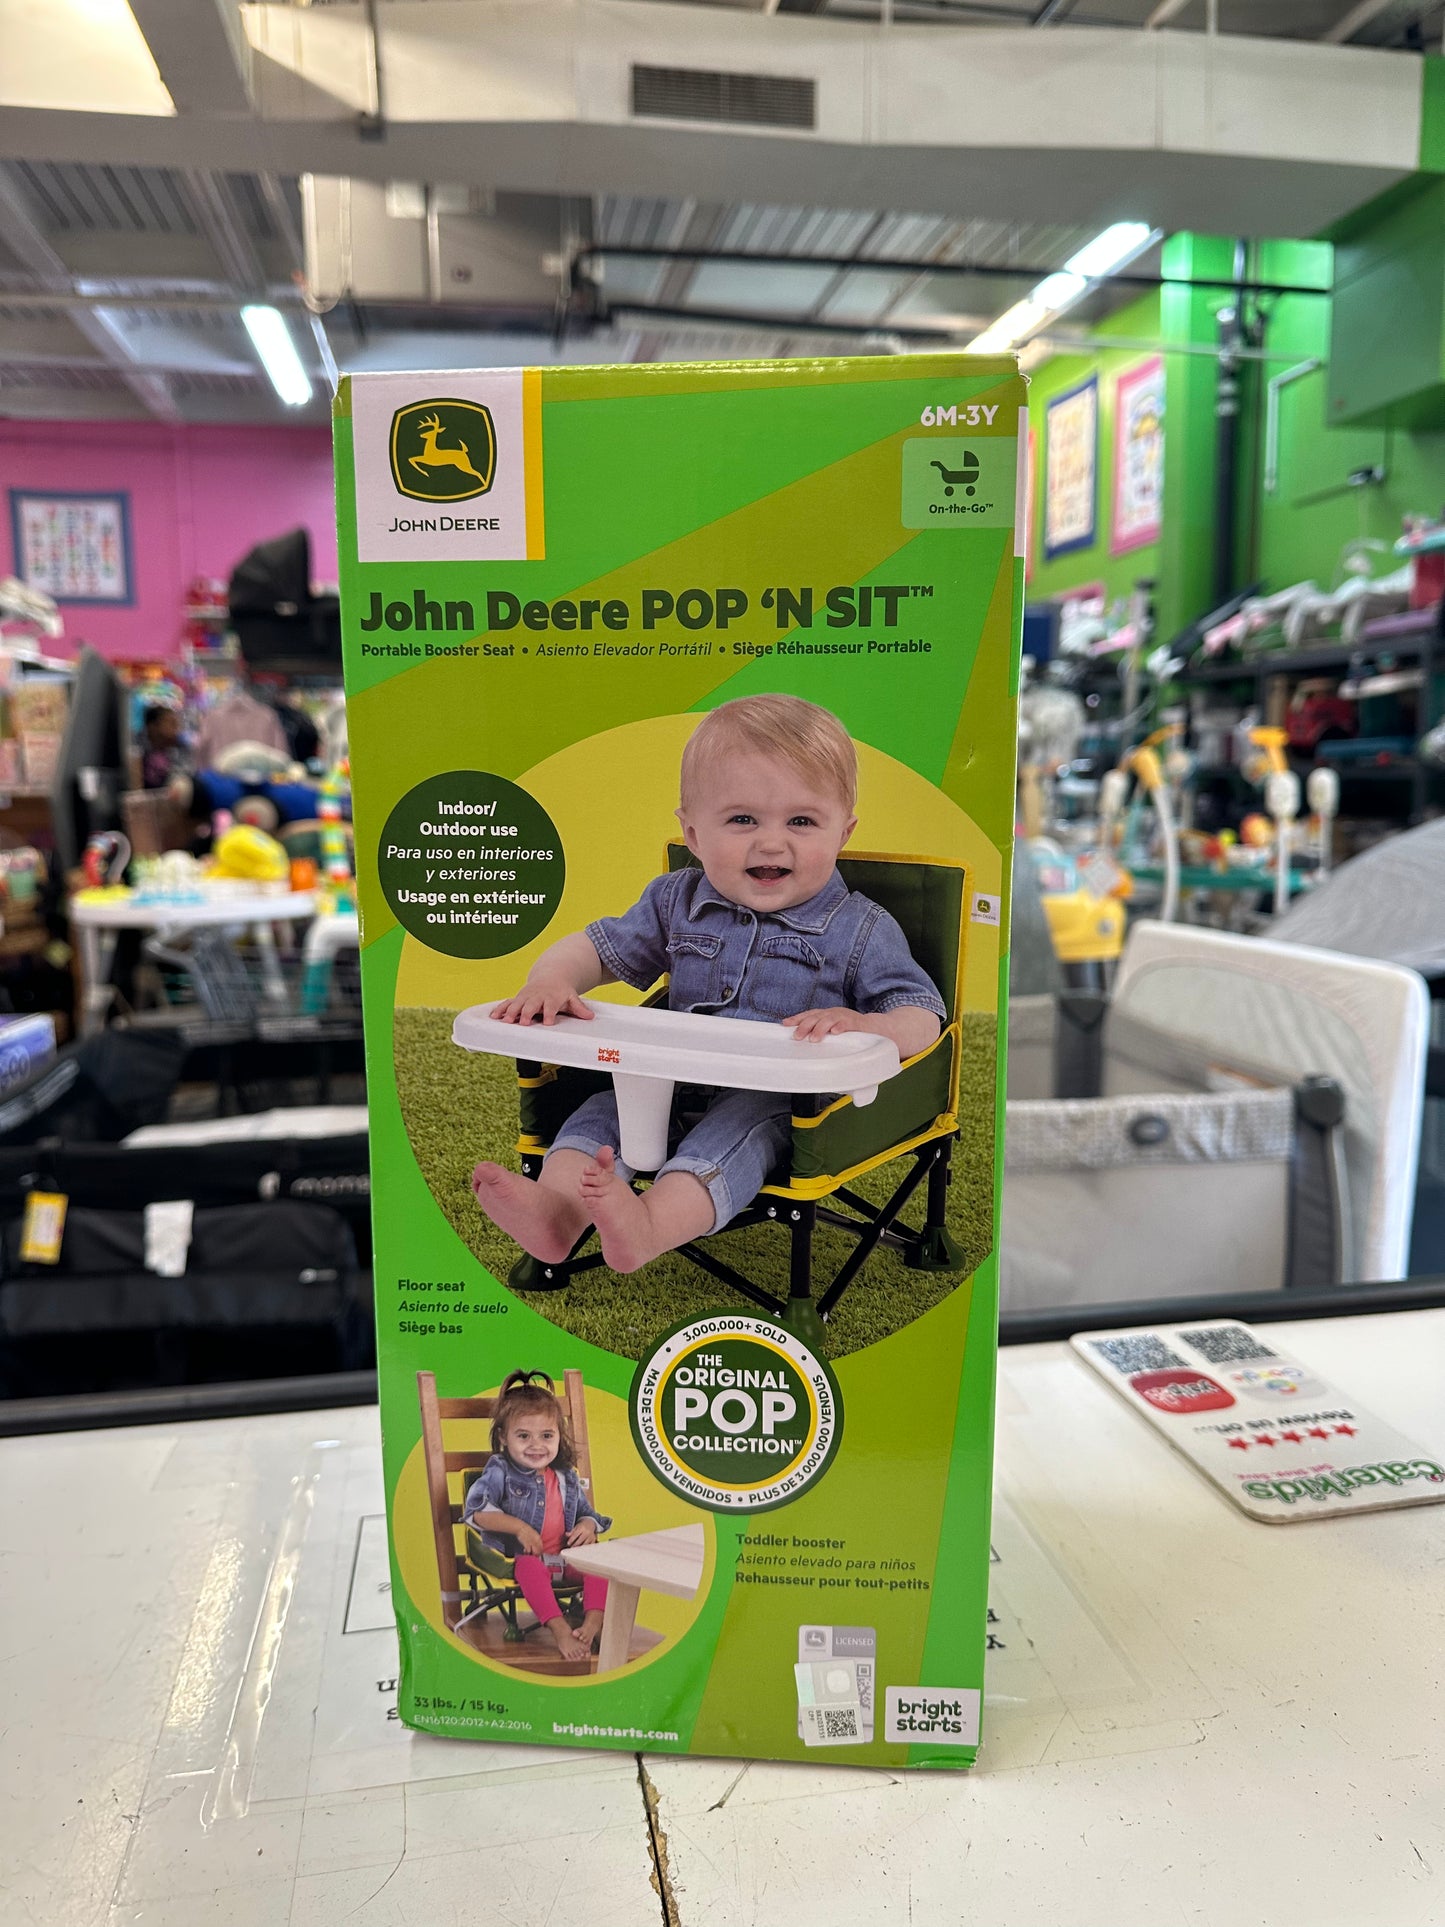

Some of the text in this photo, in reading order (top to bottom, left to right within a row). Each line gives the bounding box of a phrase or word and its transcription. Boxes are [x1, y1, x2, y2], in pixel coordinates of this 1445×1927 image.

[920, 404, 999, 427] 6M-3Y
[388, 517, 500, 532] JOHN DEERE
[360, 590, 475, 631] John
[486, 591, 629, 631] Deere
[642, 588, 748, 630] POP
[361, 639, 932, 657] Portable Booster Seat Asiento Elevador Portátil Siège Réhausseur Portable
[438, 800, 497, 817] Indoor/
[419, 821, 518, 837] Outdoor use
[387, 845, 553, 860] Para uso en interiores
[425, 867, 516, 883] y exteriores
[397, 890, 546, 906] Usage en extérieur
[426, 910, 519, 925] ou intérieur
[398, 1279, 465, 1291] Floor seat
[398, 1301, 508, 1314] Asiento de suelo
[398, 1321, 463, 1335] Siège bas
[682, 1320, 788, 1345] 3,000,000+ SOLD
[697, 1354, 723, 1366] THE
[674, 1367, 789, 1389] ORIGINAL
[641, 1397, 652, 1416] DE
[674, 1387, 797, 1435] POP
[1245, 1418, 1275, 1430] us
[1277, 1409, 1355, 1425] Review
[641, 1416, 673, 1473] 3,000,000
[748, 1374, 832, 1504] PLUS DE 3 000 000 VENDUS
[673, 1469, 733, 1504] VENDIDOS
[735, 1533, 846, 1549] Toddler booster
[735, 1553, 916, 1571] Asiento elevado para niños
[735, 1572, 930, 1591] Rehausseur pour tout-petits
[835, 1637, 874, 1646] LICENSED
[414, 1696, 509, 1714] 33 lbs. / 15 kg.
[897, 1698, 962, 1719] bright
[552, 1722, 679, 1741] brightstarts.com
